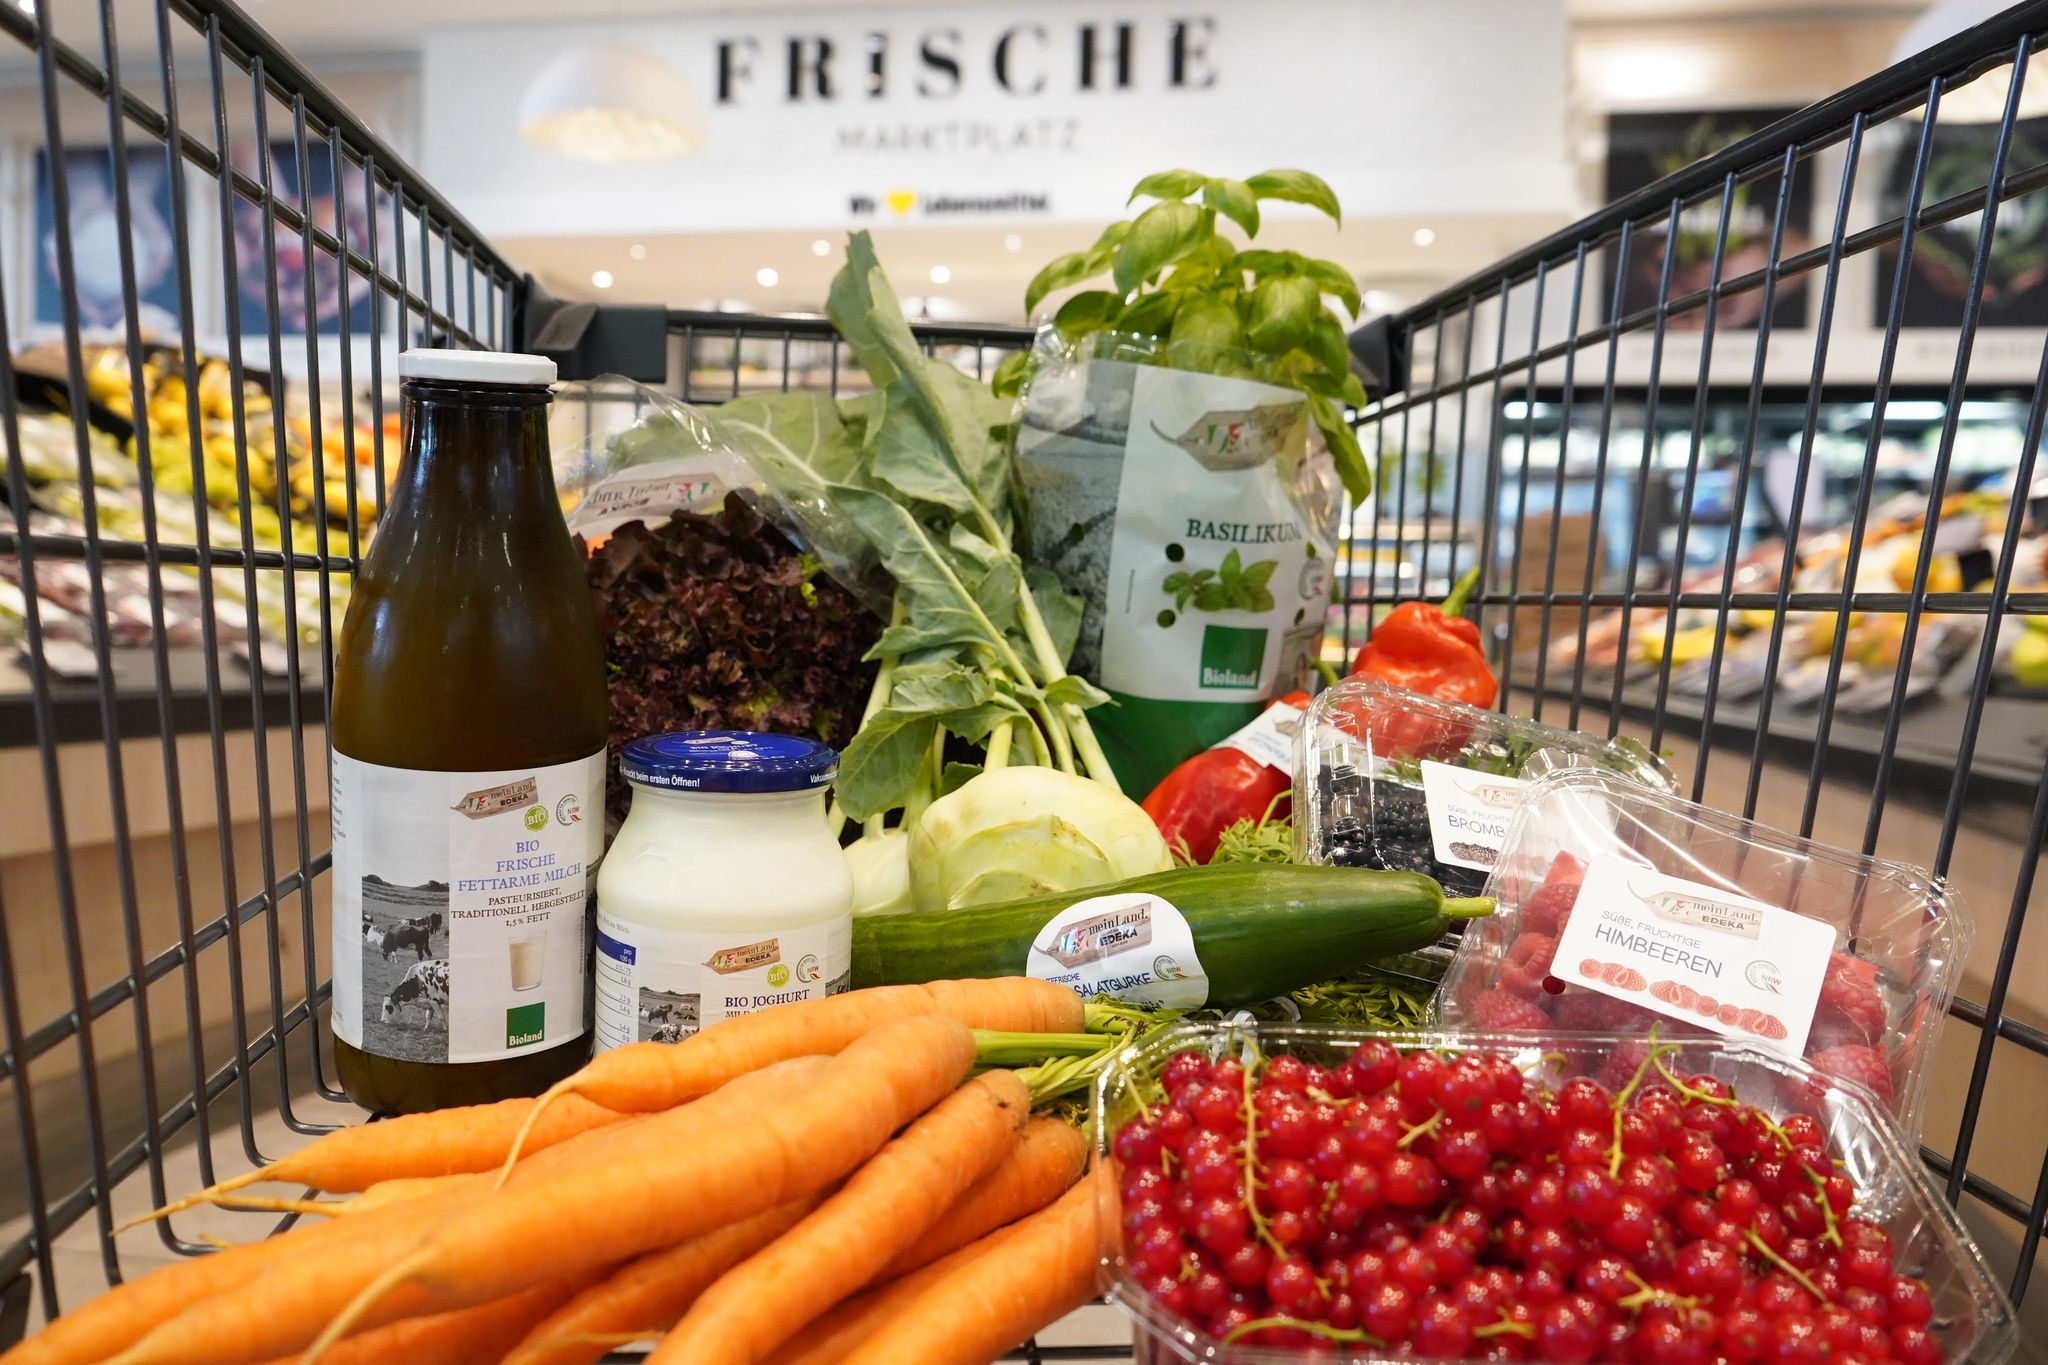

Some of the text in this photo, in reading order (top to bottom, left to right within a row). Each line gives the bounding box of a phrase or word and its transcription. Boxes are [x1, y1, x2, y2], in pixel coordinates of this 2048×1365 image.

[834, 117, 1083, 153] MARKTPLATZ
[1203, 667, 1257, 686] Bioland
[636, 769, 648, 782] beim
[649, 775, 670, 785] ersten
[671, 774, 700, 787] Öffnen!
[500, 794, 528, 806] EDEKA
[526, 811, 546, 826] BIO
[516, 839, 540, 853] BIO
[496, 853, 556, 873] FRISCHE
[458, 862, 581, 892] FETTARME MILCH
[450, 890, 585, 919] TRADITIONELL HERGESTELLT
[488, 887, 562, 906] PASTEURISIERT,
[526, 911, 551, 924] FETT
[1701, 915, 1745, 931] EDEKA
[1099, 927, 1138, 946] EDEKA
[1637, 922, 1703, 949] FRUCHTIGE
[745, 952, 772, 963] EDEKA
[1595, 923, 1723, 978] HIMBEEREN
[769, 970, 787, 982] BIO
[1073, 972, 1152, 998] SALATGURKE
[1761, 974, 1782, 986] NRW
[724, 989, 810, 1009] BIO JOGHURT
[508, 1030, 543, 1047] Bioland
